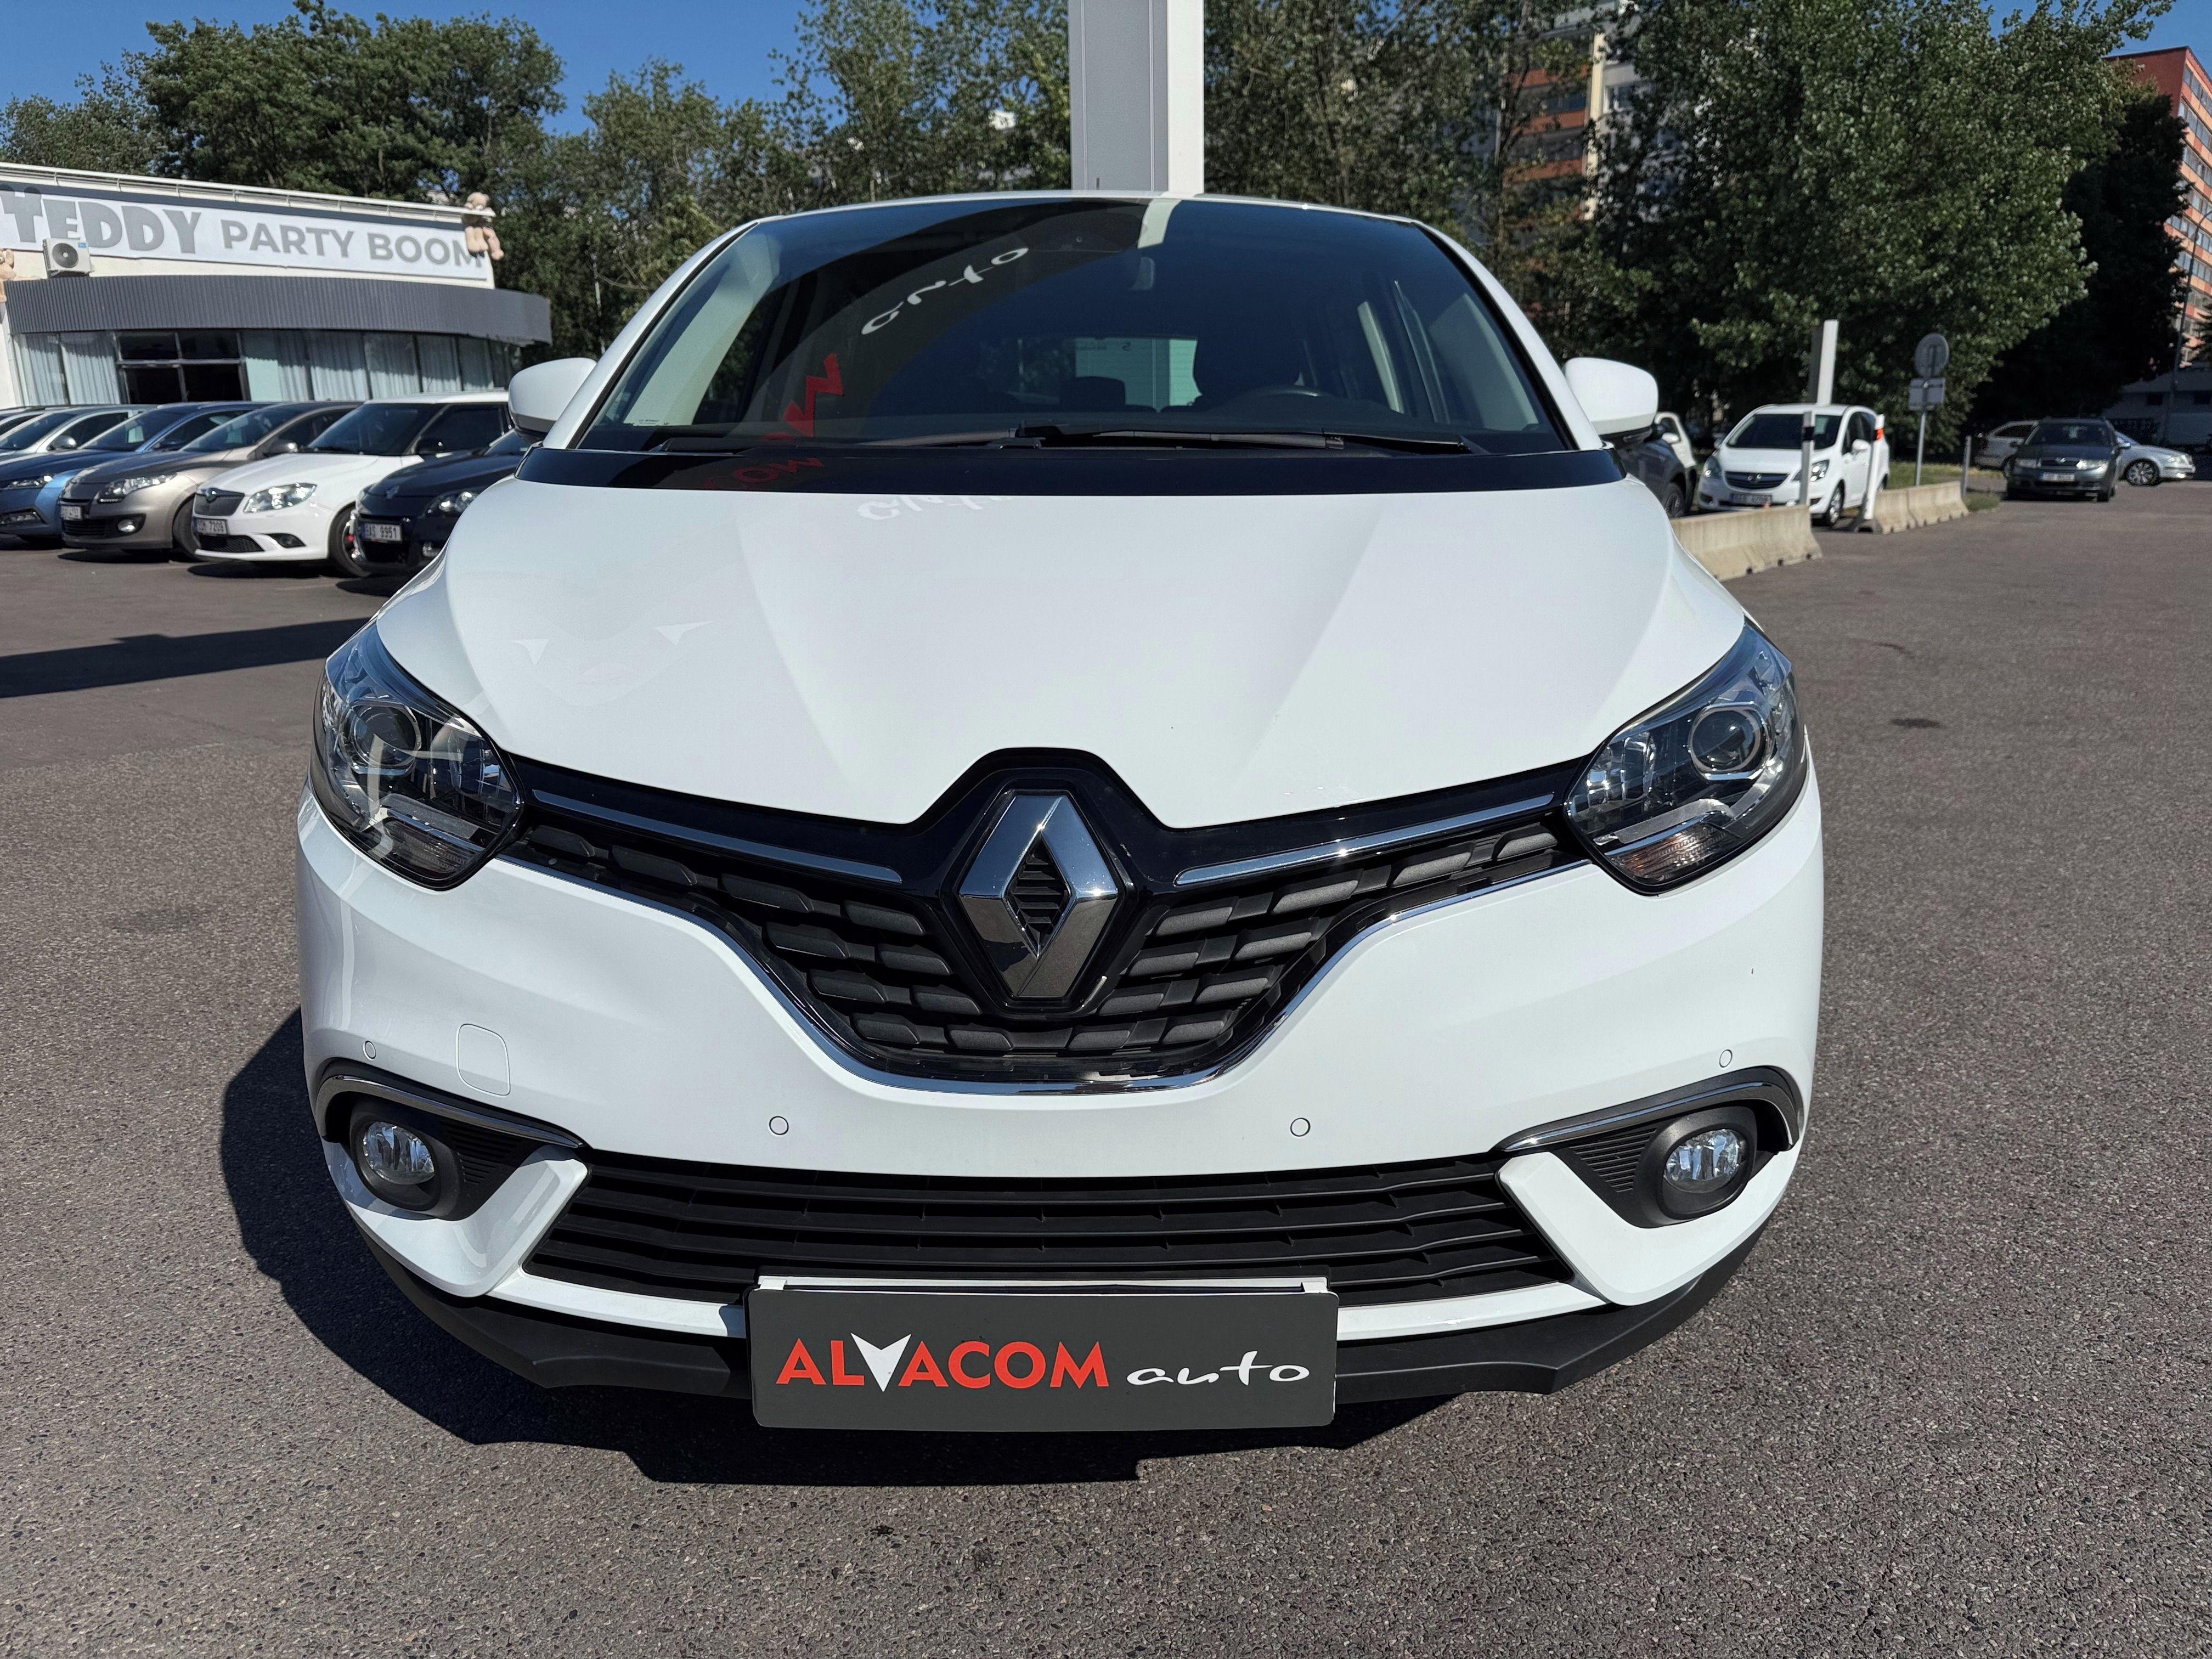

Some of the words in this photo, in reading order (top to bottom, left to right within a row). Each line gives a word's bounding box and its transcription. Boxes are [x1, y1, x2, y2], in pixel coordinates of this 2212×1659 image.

[1, 185, 201, 254] TEDDY
[220, 220, 354, 258] PARTY
[776, 1332, 1109, 1392] ALVACOM
[1126, 1350, 1310, 1386] auto
